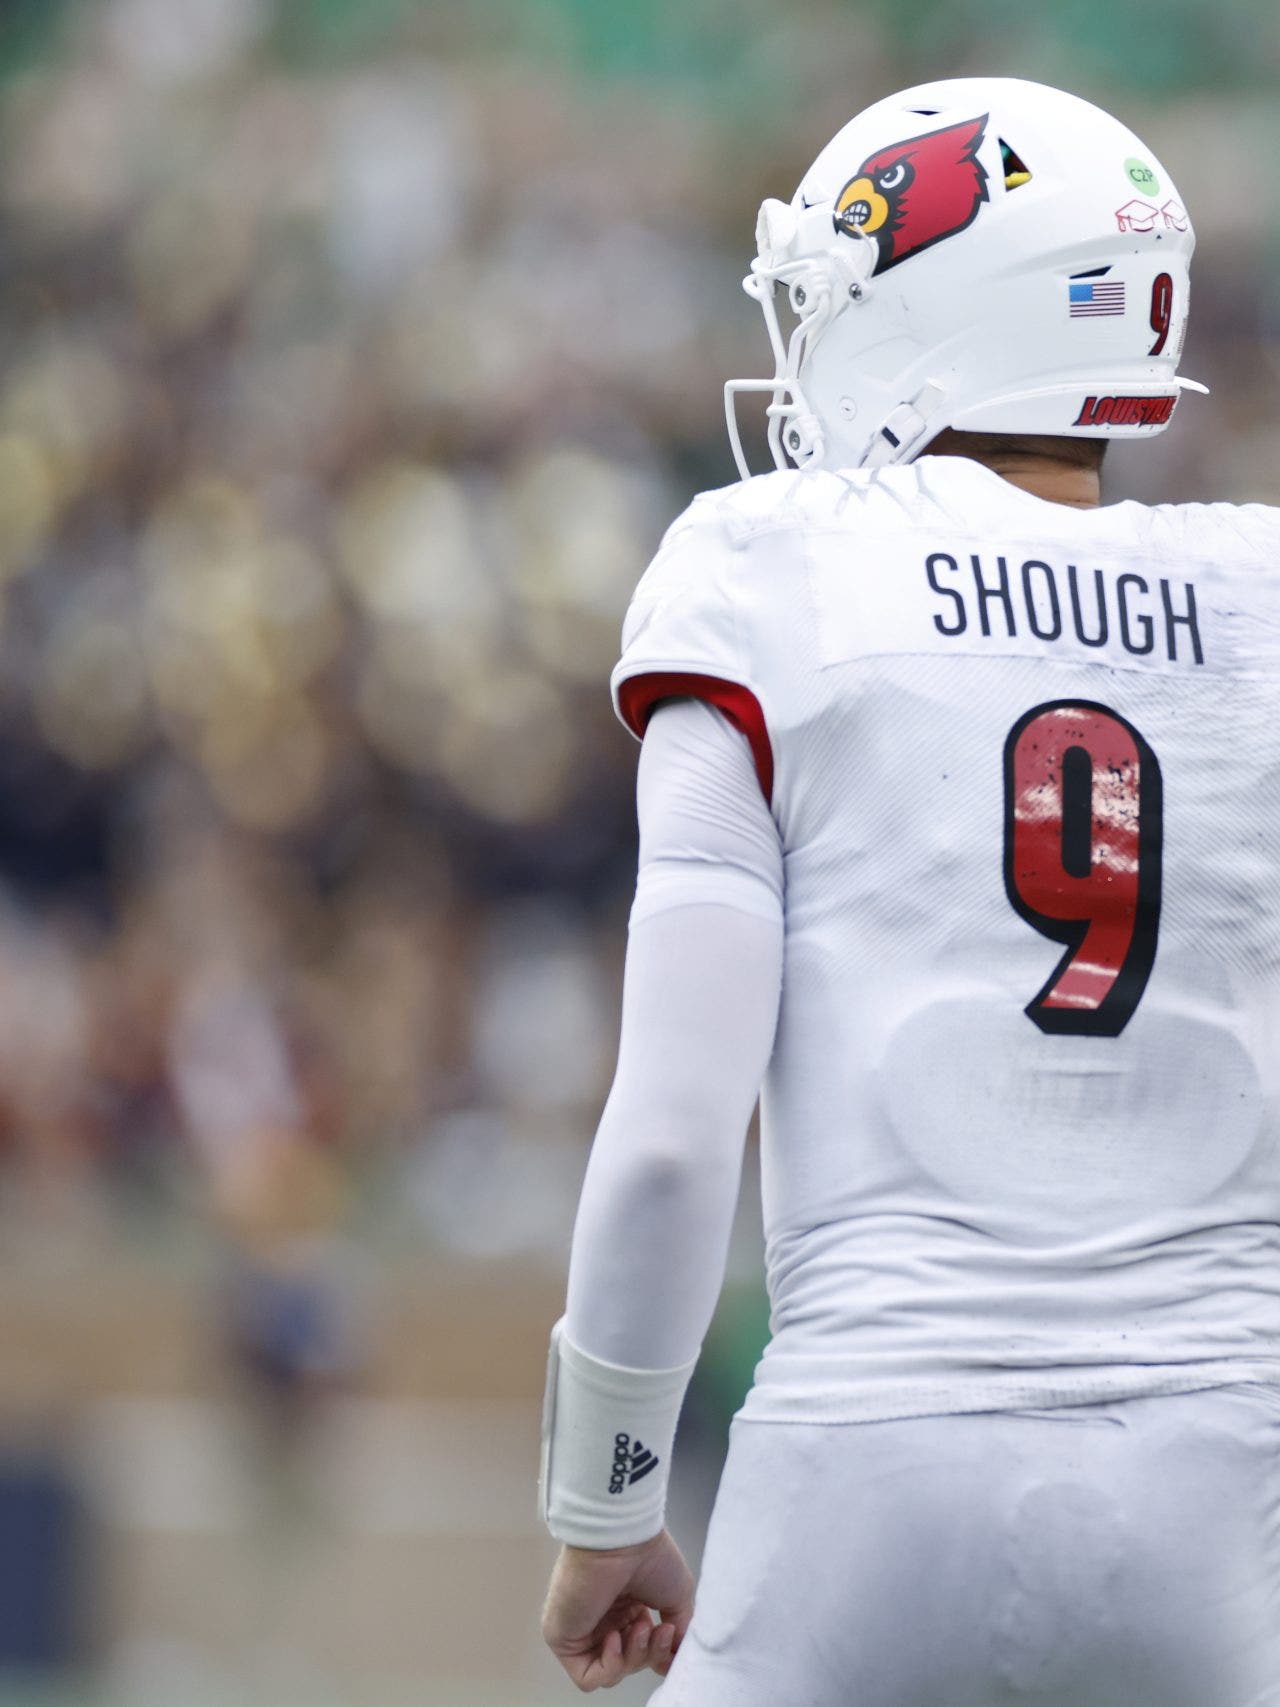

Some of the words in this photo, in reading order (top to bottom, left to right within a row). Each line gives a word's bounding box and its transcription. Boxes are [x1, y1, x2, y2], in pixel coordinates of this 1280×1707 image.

[1148, 272, 1174, 356] 9
[925, 552, 1204, 665] SHOUGH
[1002, 698, 1164, 1037] 9
[607, 1433, 633, 1494] adidas
